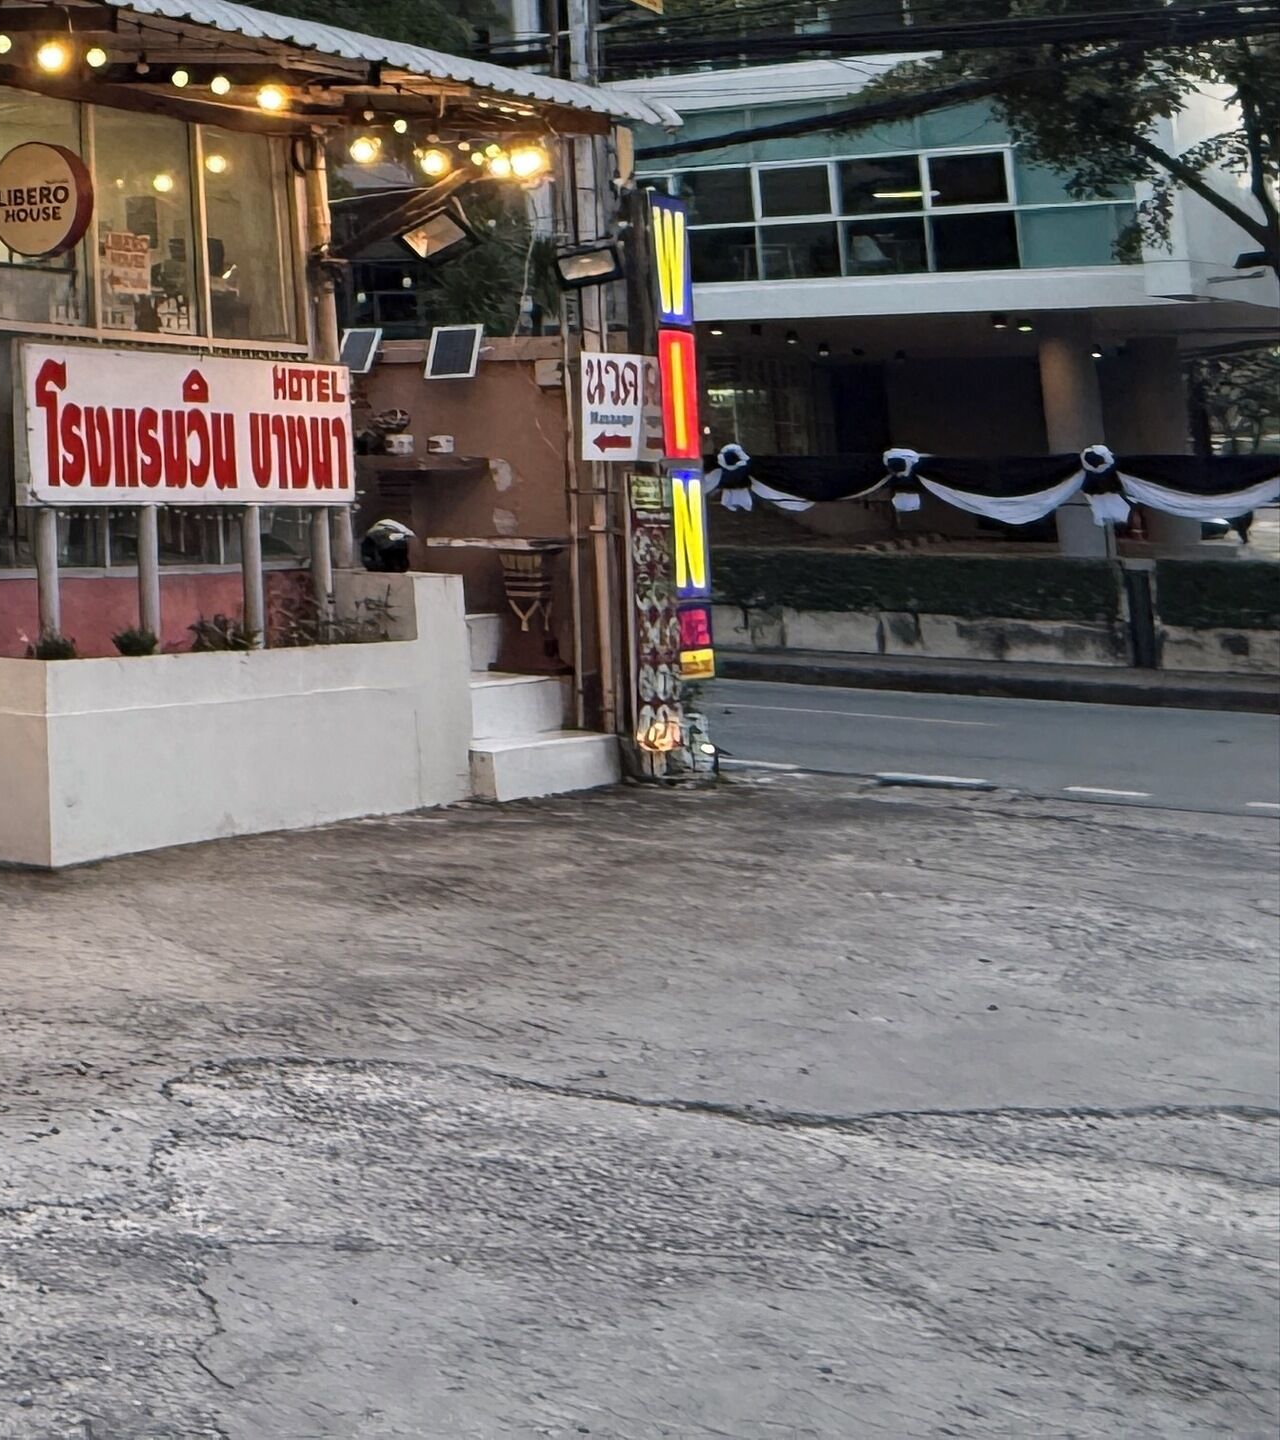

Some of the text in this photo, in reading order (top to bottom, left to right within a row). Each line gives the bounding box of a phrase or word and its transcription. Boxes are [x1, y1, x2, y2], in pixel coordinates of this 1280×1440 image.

[4, 206, 62, 224] HOUSE
[272, 364, 346, 403] HOTEL
[585, 358, 639, 407] นวด
[35, 358, 349, 490] โรงแรมวิน บางนา
